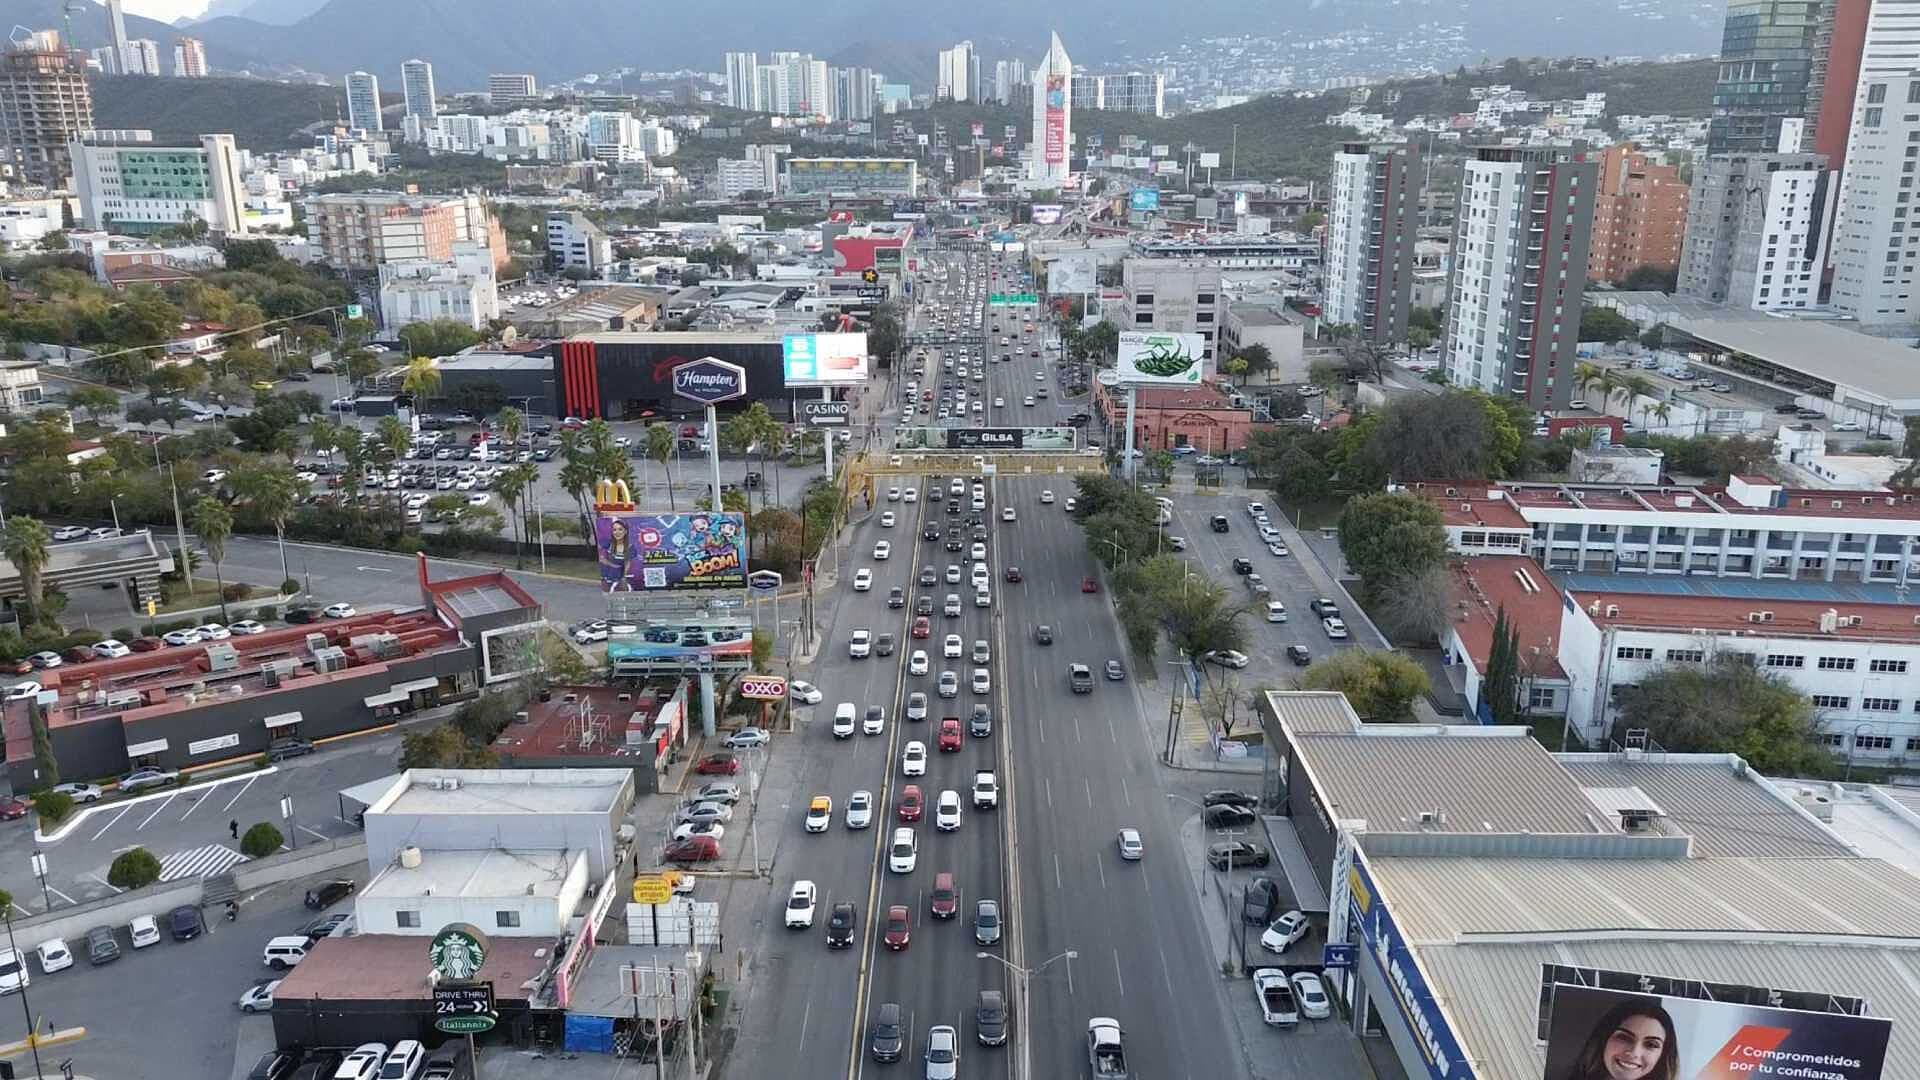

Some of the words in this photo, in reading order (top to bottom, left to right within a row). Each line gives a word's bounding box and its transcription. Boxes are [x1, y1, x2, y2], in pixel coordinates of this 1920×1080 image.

[676, 371, 738, 387] Hampton
[805, 404, 849, 414] CASINO
[982, 433, 1014, 442] GILSA
[743, 682, 783, 695] OXXO
[435, 991, 461, 999] DRIVE
[436, 1001, 456, 1013] 24
[1390, 959, 1450, 1077] MICHELIN
[1743, 1046, 1861, 1068] Comprometidos
[1729, 1061, 1755, 1071] por
[1758, 1062, 1773, 1074] tu
[1776, 1065, 1848, 1080] confianza.
